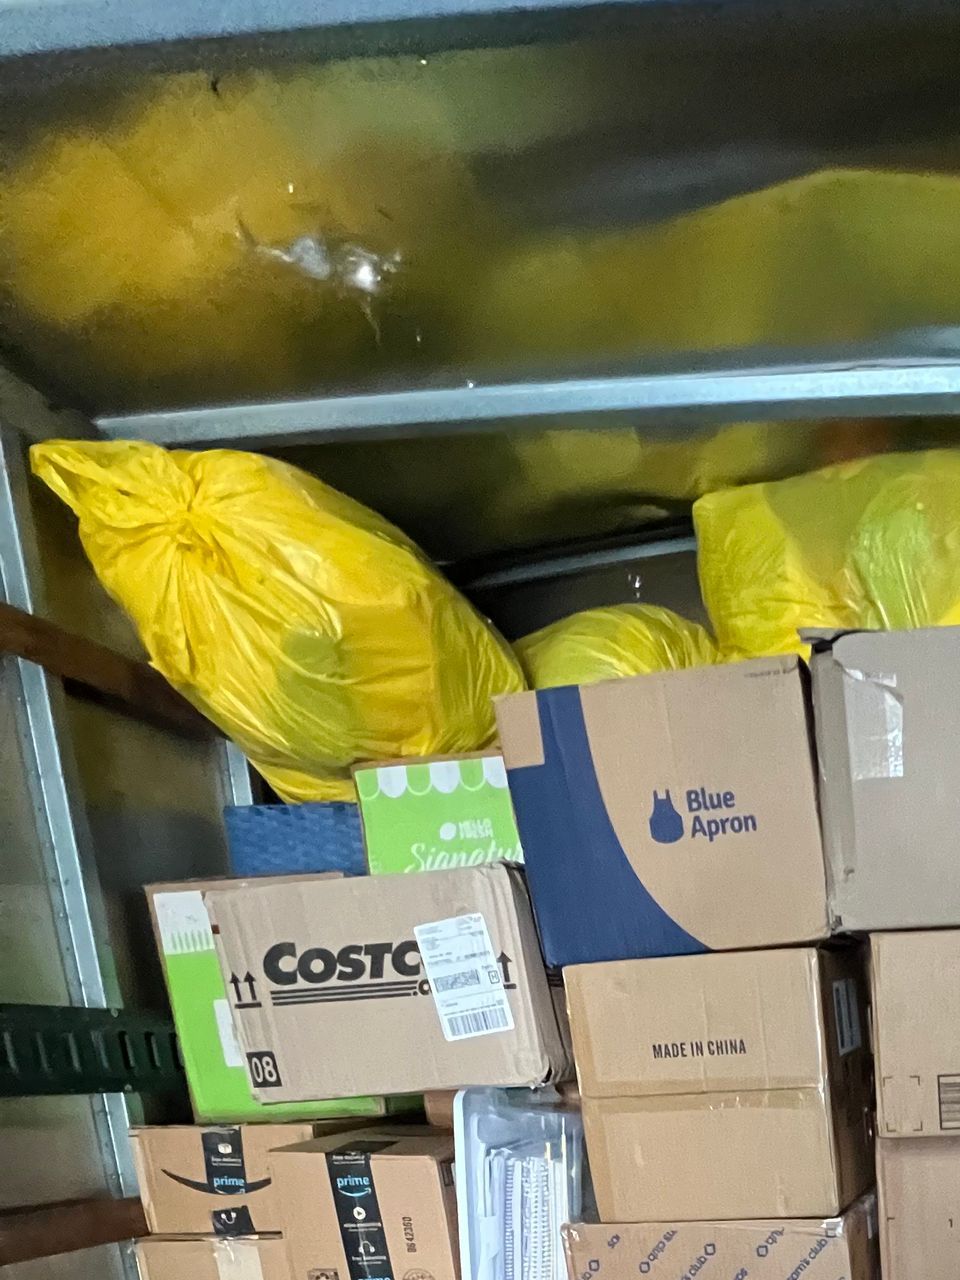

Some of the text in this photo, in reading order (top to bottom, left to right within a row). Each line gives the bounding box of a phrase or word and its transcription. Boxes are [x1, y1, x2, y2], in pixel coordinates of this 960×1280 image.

[685, 786, 735, 812] Blue
[690, 814, 757, 842] Apron
[263, 940, 421, 985] COSTC
[651, 1038, 747, 1060] MADE IN CHINA
[252, 1055, 279, 1084] 08
[213, 1175, 246, 1187] prime
[336, 1174, 370, 1188] prime
[648, 1240, 666, 1262] club
[808, 1238, 828, 1260] club
[688, 1256, 706, 1277] club
